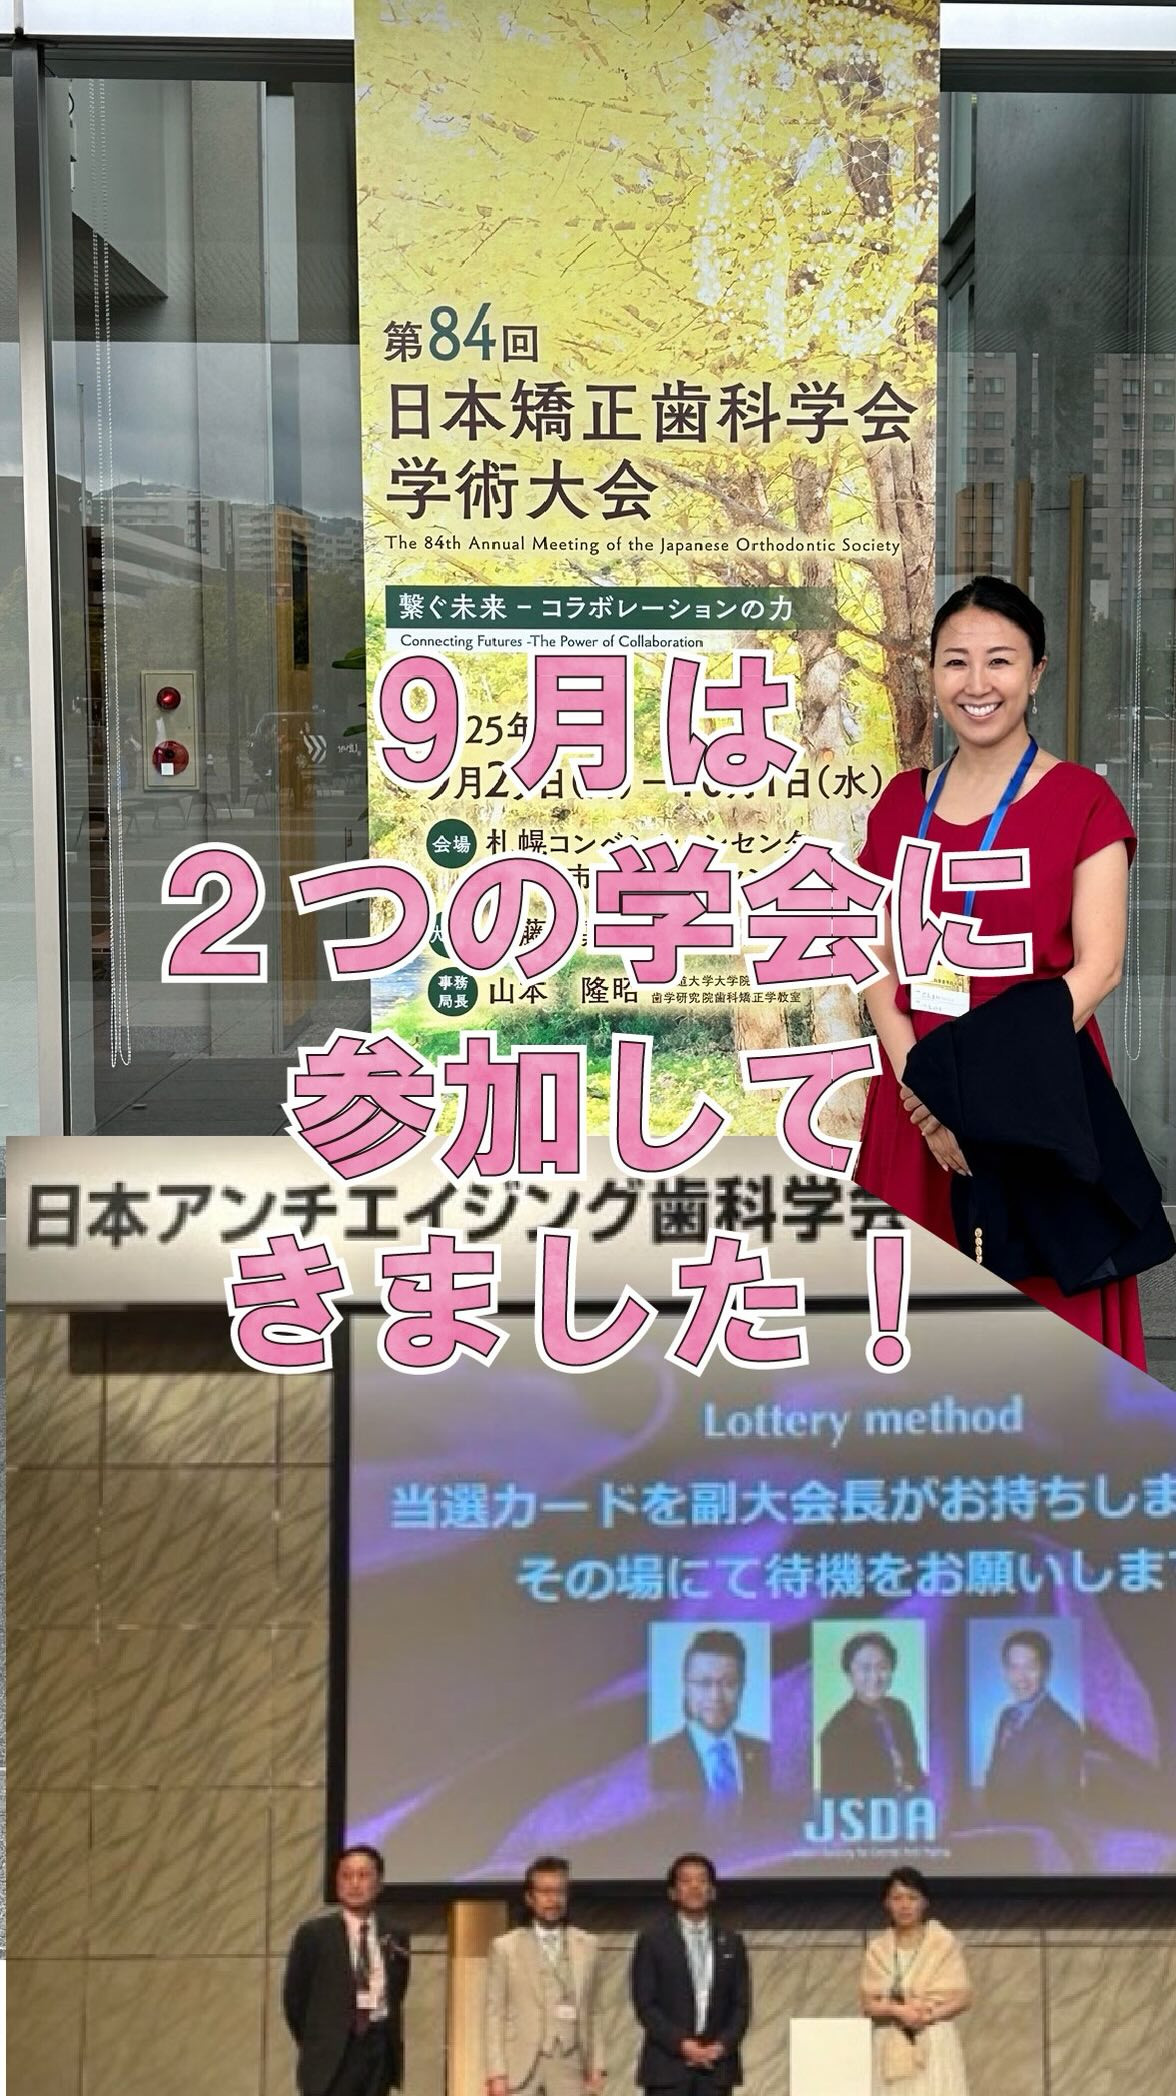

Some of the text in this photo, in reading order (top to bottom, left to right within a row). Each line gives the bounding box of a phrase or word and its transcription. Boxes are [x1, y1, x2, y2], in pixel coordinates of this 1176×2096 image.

[383, 303, 539, 363] 第84回
[389, 378, 919, 444] 日本矯正歯科学会
[386, 456, 659, 520] 学術大会
[384, 534, 900, 556] The 84th Annual Meeting of the Japanese Orthodontic Society
[400, 634, 473, 650] Connecting
[478, 635, 522, 647] Futures
[560, 635, 598, 647] Power
[602, 633, 617, 647] of
[617, 634, 704, 648] Collaboration
[432, 835, 471, 854] 会場
[438, 975, 468, 990] 事務
[489, 976, 638, 1004] 山本 隆昭
[677, 974, 750, 987] 道大学大学院
[438, 994, 468, 1009] 局長
[652, 991, 801, 1004] 歯学研究院歯科矯正学教室
[702, 1394, 1025, 1448] Lottery method
[515, 1547, 1176, 1603] その場にて待機をお願いしま
[805, 1797, 937, 1842] JSDA
